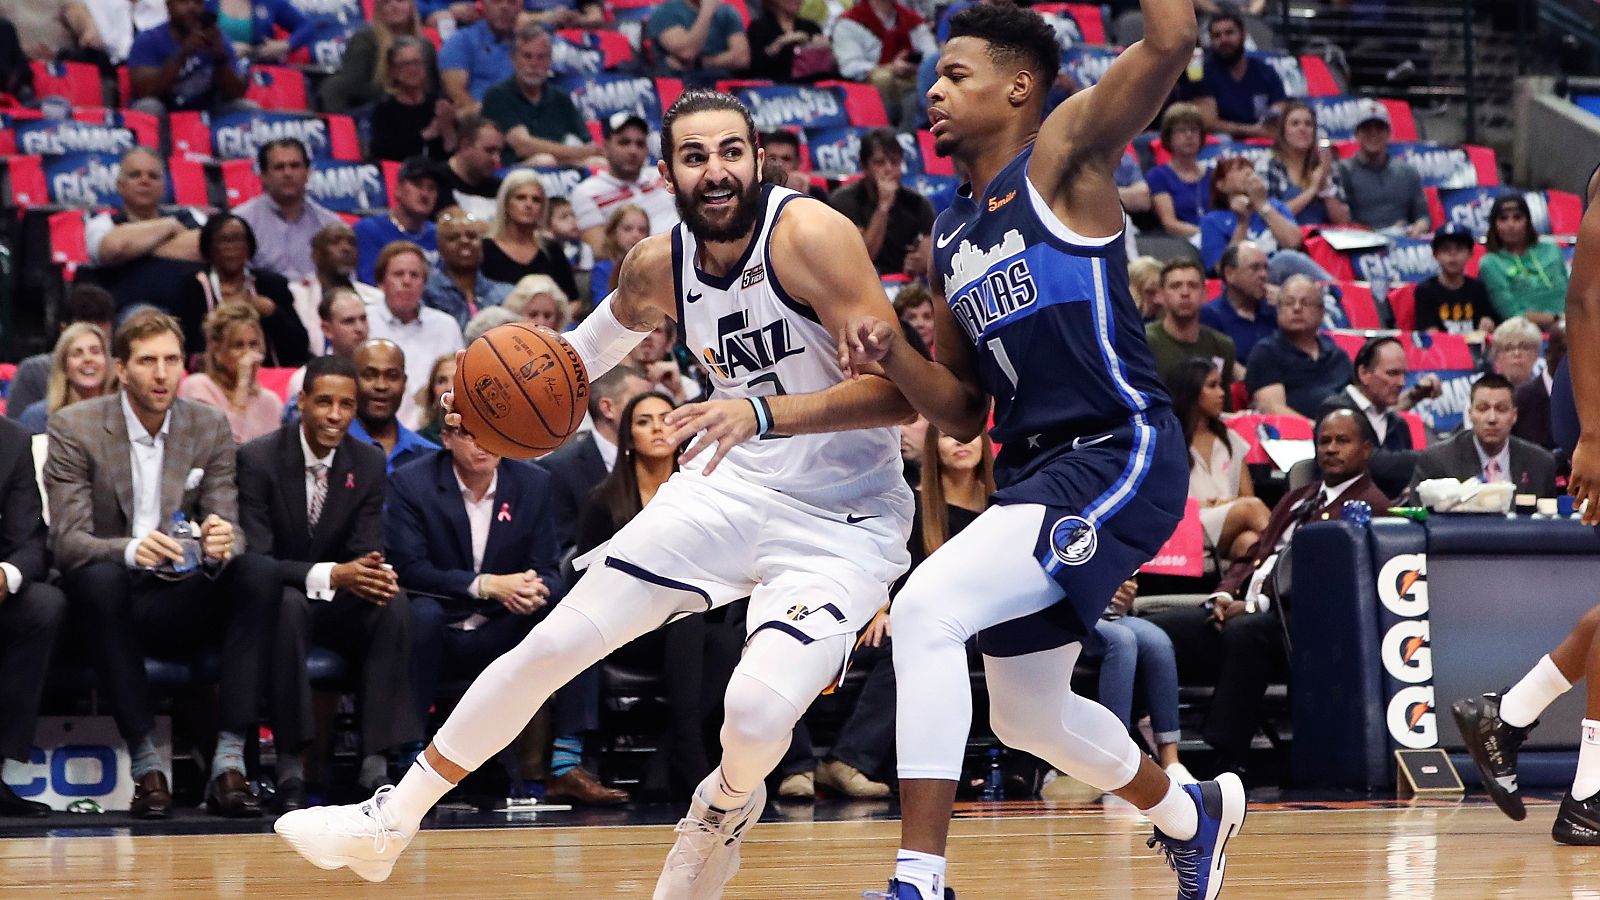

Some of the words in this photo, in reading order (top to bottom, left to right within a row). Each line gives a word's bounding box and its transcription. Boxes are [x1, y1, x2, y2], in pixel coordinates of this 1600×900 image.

[950, 258, 1038, 345] DALLAS
[1377, 553, 1429, 617] G
[1381, 619, 1433, 683] G
[1386, 685, 1438, 749] G
